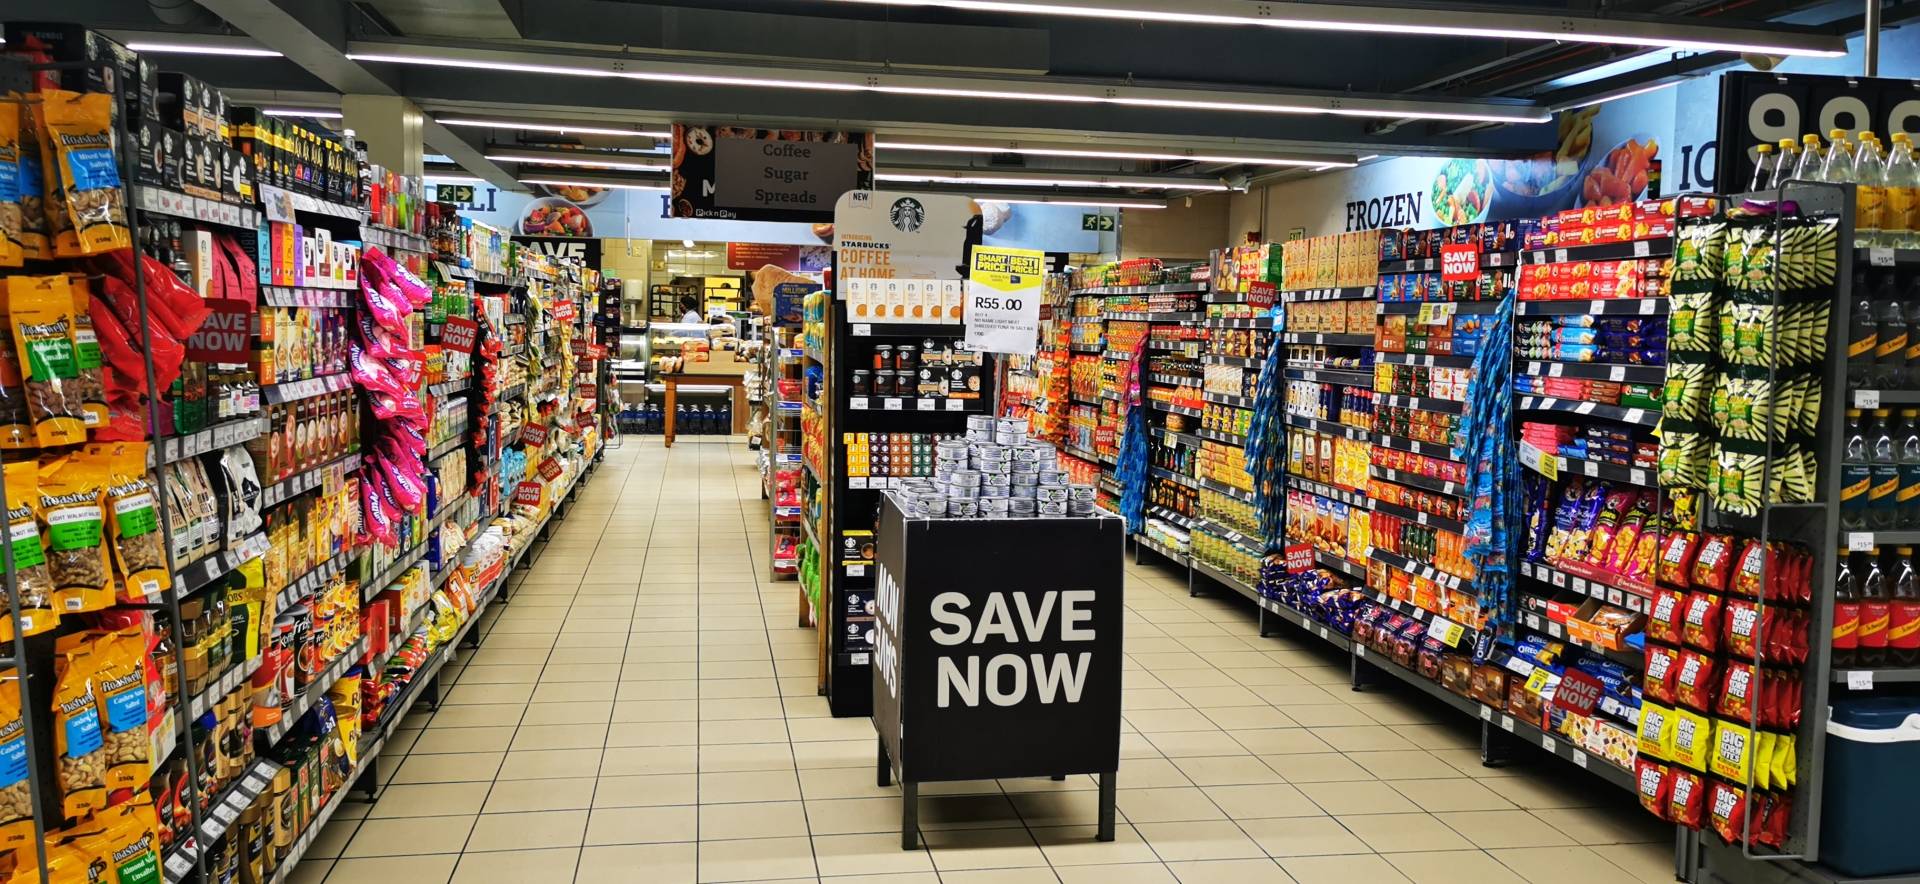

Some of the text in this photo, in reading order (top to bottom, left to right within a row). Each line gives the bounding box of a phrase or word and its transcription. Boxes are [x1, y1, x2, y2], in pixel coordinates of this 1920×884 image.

[763, 144, 811, 158] Coffee
[764, 167, 808, 183] Sugar
[755, 189, 816, 204] Spreads
[1346, 191, 1422, 232] FROZEN
[841, 241, 890, 249] STARBUCKS
[840, 249, 890, 265] COFFEE
[978, 254, 1007, 263] SMART
[1443, 251, 1475, 263] SAVE
[840, 267, 856, 280] AT
[977, 262, 1007, 271] PRICE
[1444, 262, 1475, 274] NOW
[1251, 286, 1275, 296] SAVE
[1249, 294, 1273, 304] NOW
[446, 323, 475, 337] SAVE
[189, 332, 246, 351] NOW
[443, 333, 472, 348] NOW
[523, 432, 543, 444] NOW
[525, 426, 545, 437] SAVE
[545, 466, 560, 478] NOW
[518, 493, 540, 501] NOW
[519, 486, 540, 494] SAVE
[1287, 549, 1312, 560] SAVE
[1288, 558, 1312, 569] NOW
[1658, 594, 1676, 608] BIG
[1692, 599, 1710, 611] BIG
[930, 590, 1096, 646] SAVE
[1734, 607, 1757, 621] BIG
[1477, 635, 1486, 658] OREO
[1518, 645, 1537, 655] OREO
[1651, 651, 1671, 667] BIG
[1684, 656, 1701, 672] BIG
[102, 669, 143, 692] Roastwell
[937, 652, 1092, 707] NOW
[1597, 675, 1620, 686] OREO
[1731, 668, 1750, 684] BIG
[1562, 676, 1599, 698] SAVE
[1556, 687, 1593, 710] NOW
[1646, 711, 1664, 726] BIG
[1678, 718, 1696, 733] BIG
[1722, 729, 1744, 747] BIG
[1641, 767, 1661, 783] BIG
[1717, 761, 1740, 776] EXTRA
[1676, 776, 1693, 791] BIG
[1717, 788, 1737, 806] BIG
